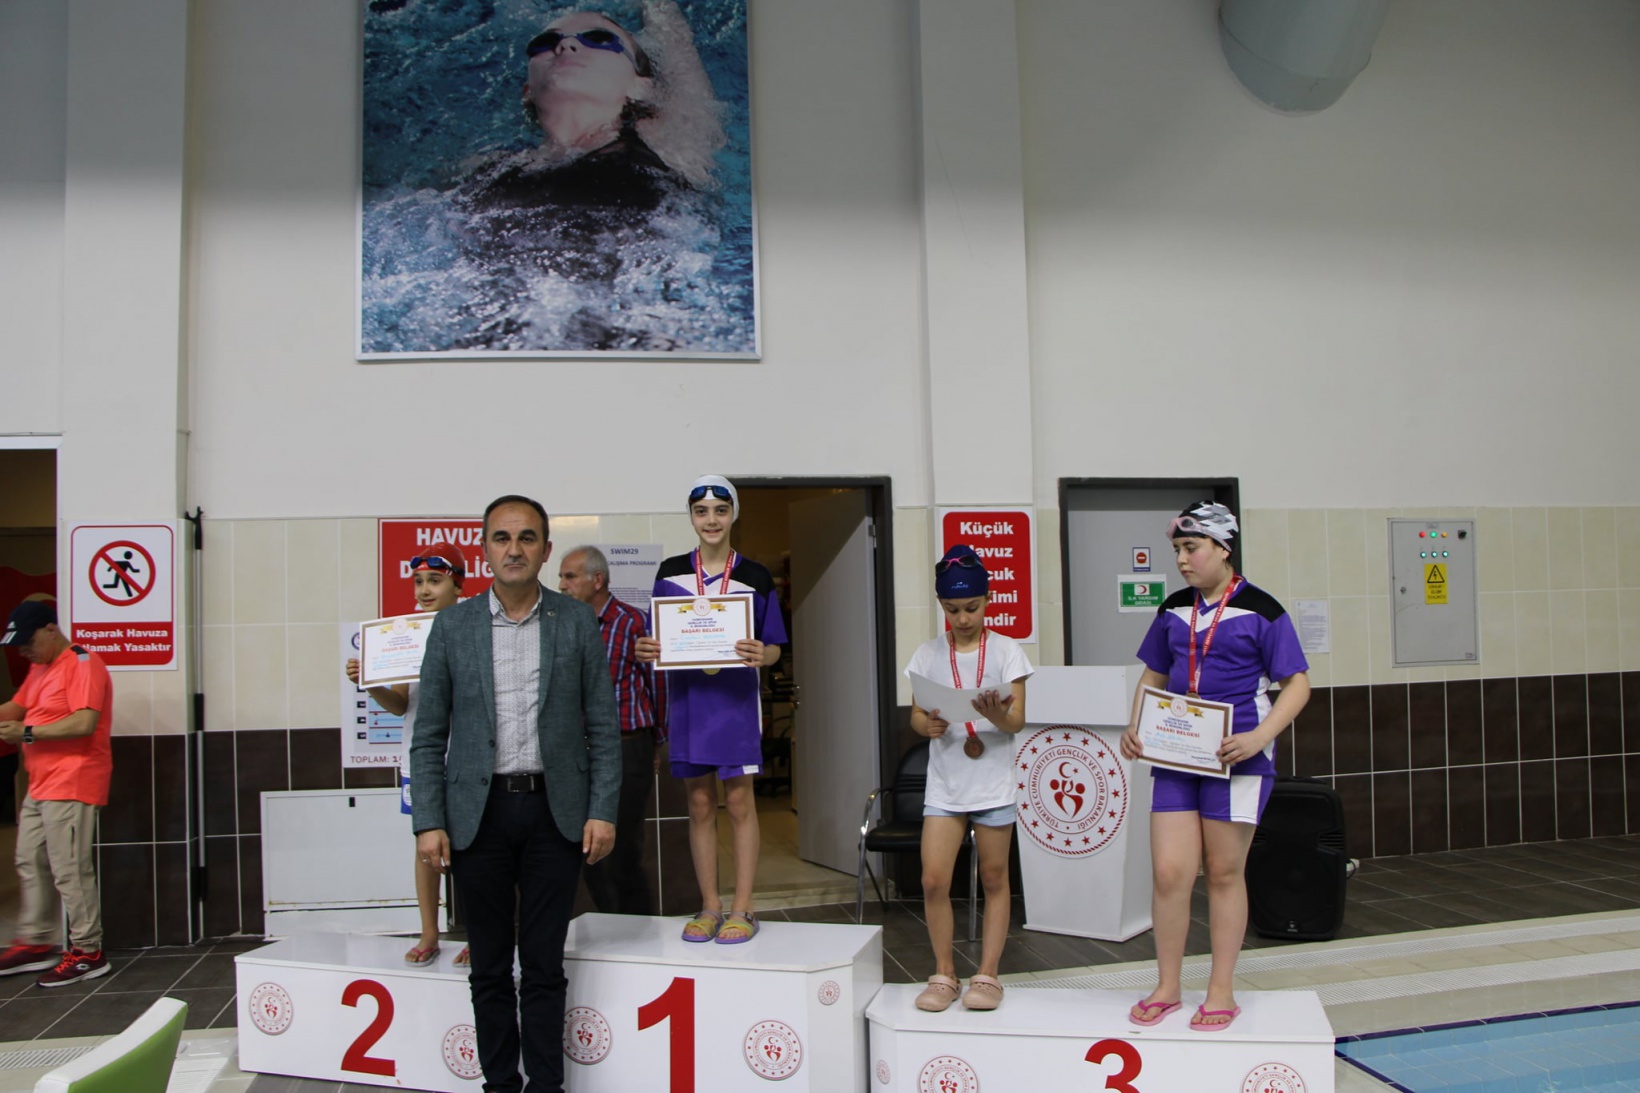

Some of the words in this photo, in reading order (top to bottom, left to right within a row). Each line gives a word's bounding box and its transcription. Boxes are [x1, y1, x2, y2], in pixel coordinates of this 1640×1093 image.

[960, 521, 1014, 538] Küçük
[969, 545, 1013, 558] avuz
[76, 629, 124, 640] Koşarak
[126, 629, 168, 638] Havuza
[124, 642, 171, 652] Yasaktır
[350, 756, 389, 764] TOPLAM:
[1056, 748, 1088, 762] GENÇLİK
[1030, 750, 1056, 799] CUMHURİYETİ
[1088, 760, 1097, 770] VE
[1095, 771, 1105, 793] SPOR
[1034, 801, 1059, 829] TÜRKİYE
[1077, 795, 1105, 830] BAKANLIĞI
[341, 979, 396, 1077] 2
[638, 976, 695, 1093] 1
[1085, 1038, 1142, 1093] 3
